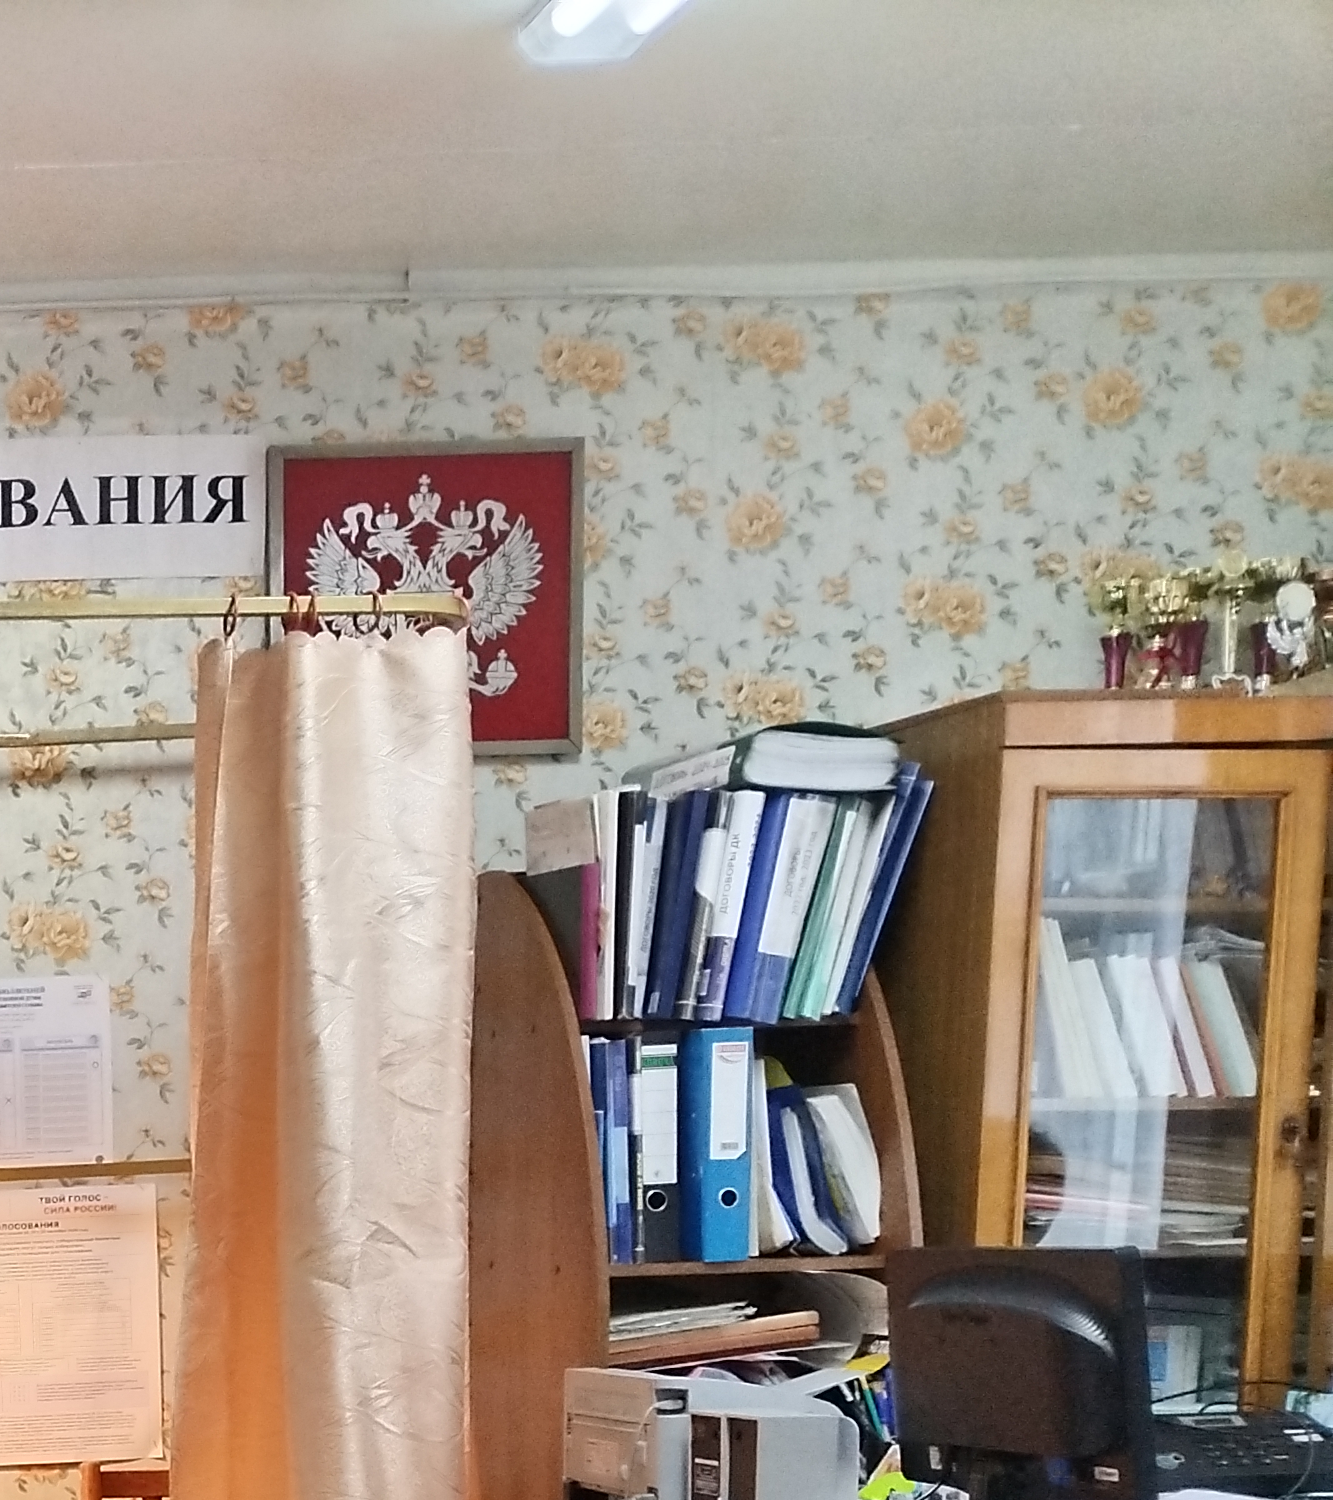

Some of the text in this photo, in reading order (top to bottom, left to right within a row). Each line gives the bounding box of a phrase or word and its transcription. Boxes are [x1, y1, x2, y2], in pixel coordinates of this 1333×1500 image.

[719, 833, 741, 915] ДОГОВОРЫ ДК
[39, 1193, 66, 1204] ТВОЙ
[68, 1193, 102, 1203] ГОЛОС
